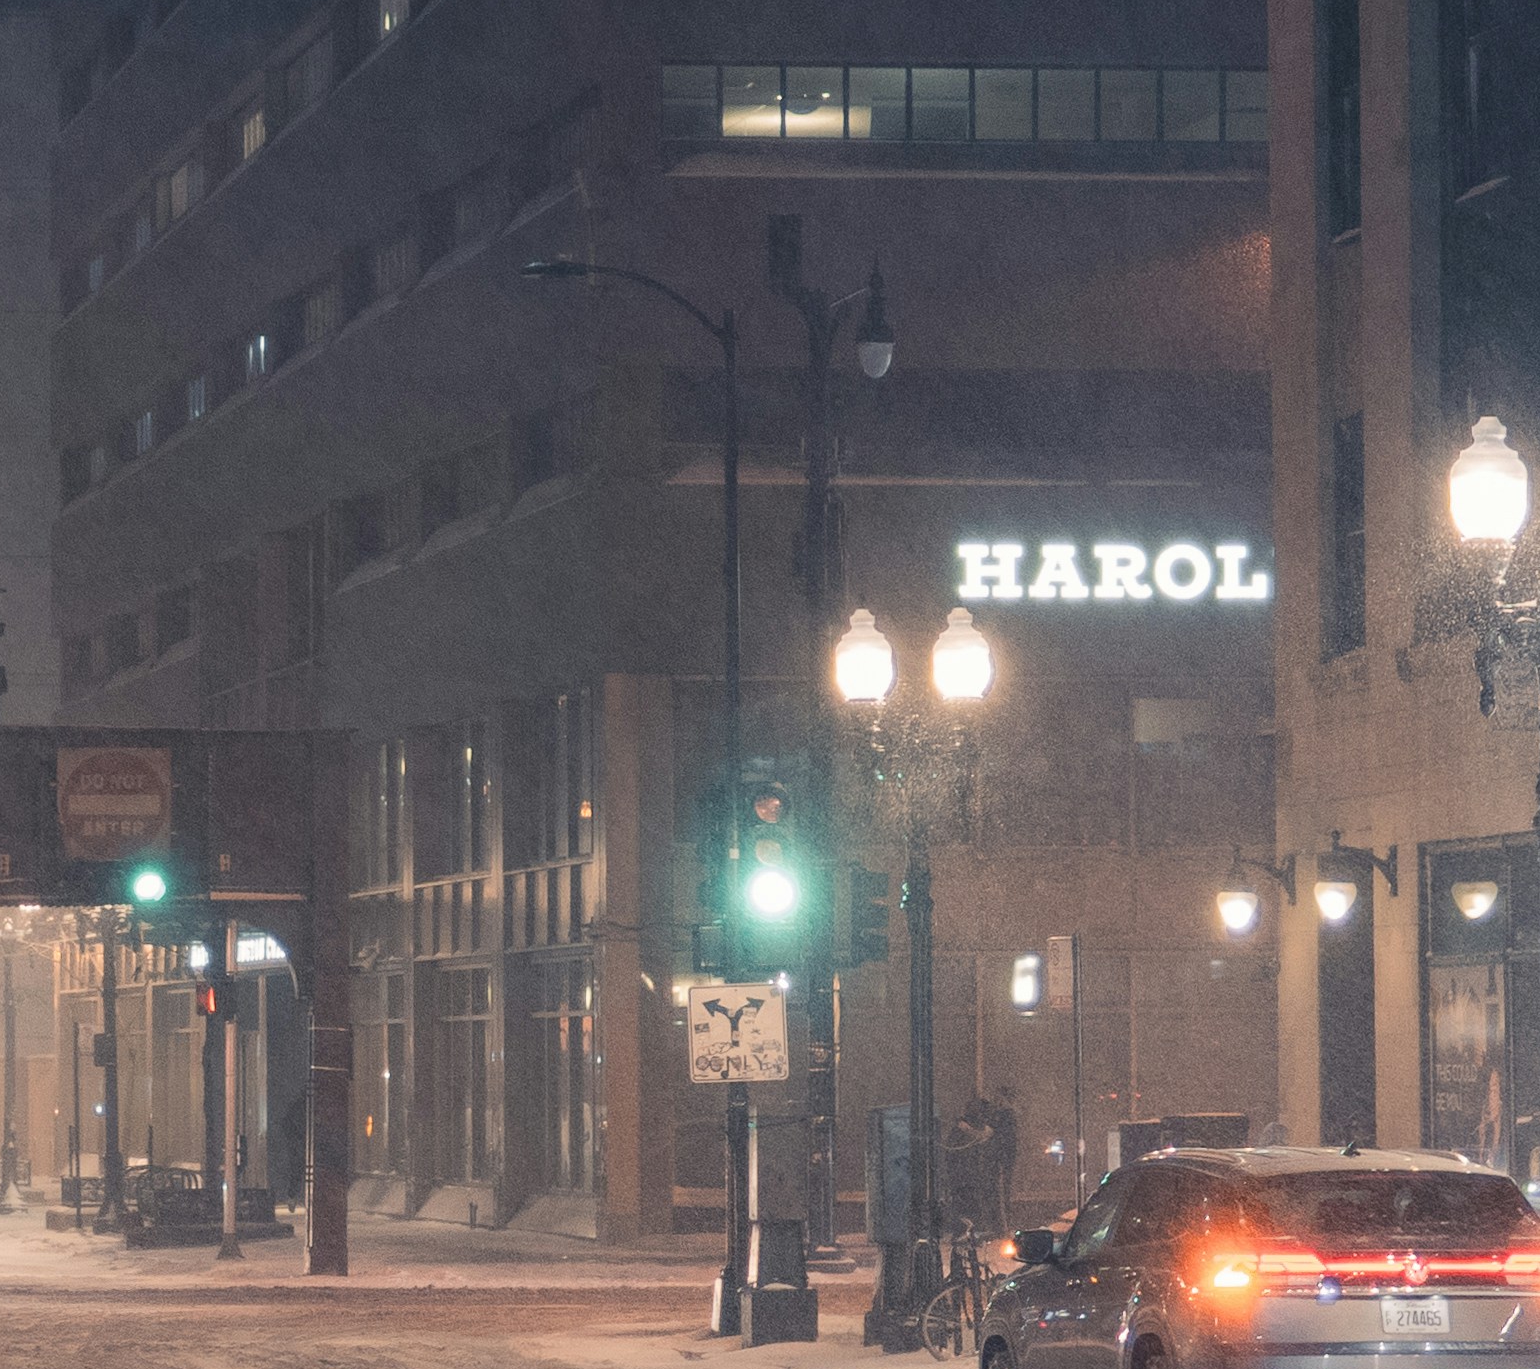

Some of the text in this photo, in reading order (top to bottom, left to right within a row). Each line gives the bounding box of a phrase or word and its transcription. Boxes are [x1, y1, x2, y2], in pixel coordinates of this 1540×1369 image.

[957, 543, 1274, 600] HAROL
[80, 773, 146, 790] DO NOT
[83, 820, 145, 836] ENTER
[1397, 1310, 1442, 1327] 274465
